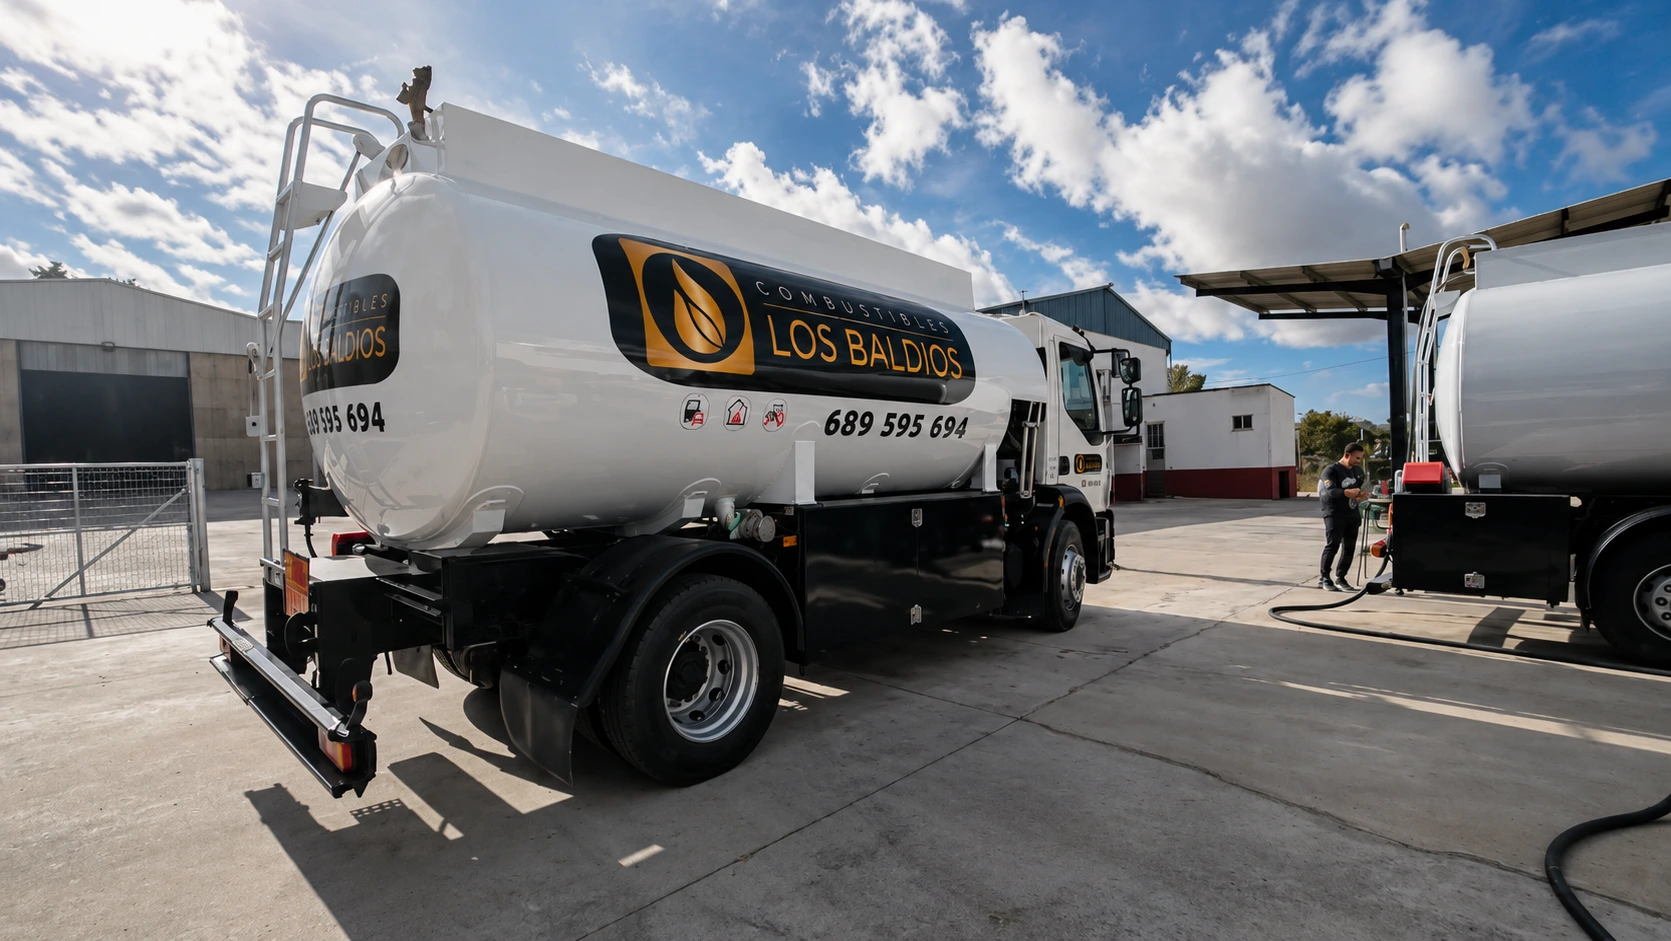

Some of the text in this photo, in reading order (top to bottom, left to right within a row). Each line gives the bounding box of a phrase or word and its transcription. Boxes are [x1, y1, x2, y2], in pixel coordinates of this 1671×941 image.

[755, 281, 949, 334] COMBUSTIBLES
[767, 314, 963, 380] LOS BALDIOS
[319, 405, 343, 434] 595
[346, 401, 386, 433] 694
[824, 409, 969, 439] 689 595 694
